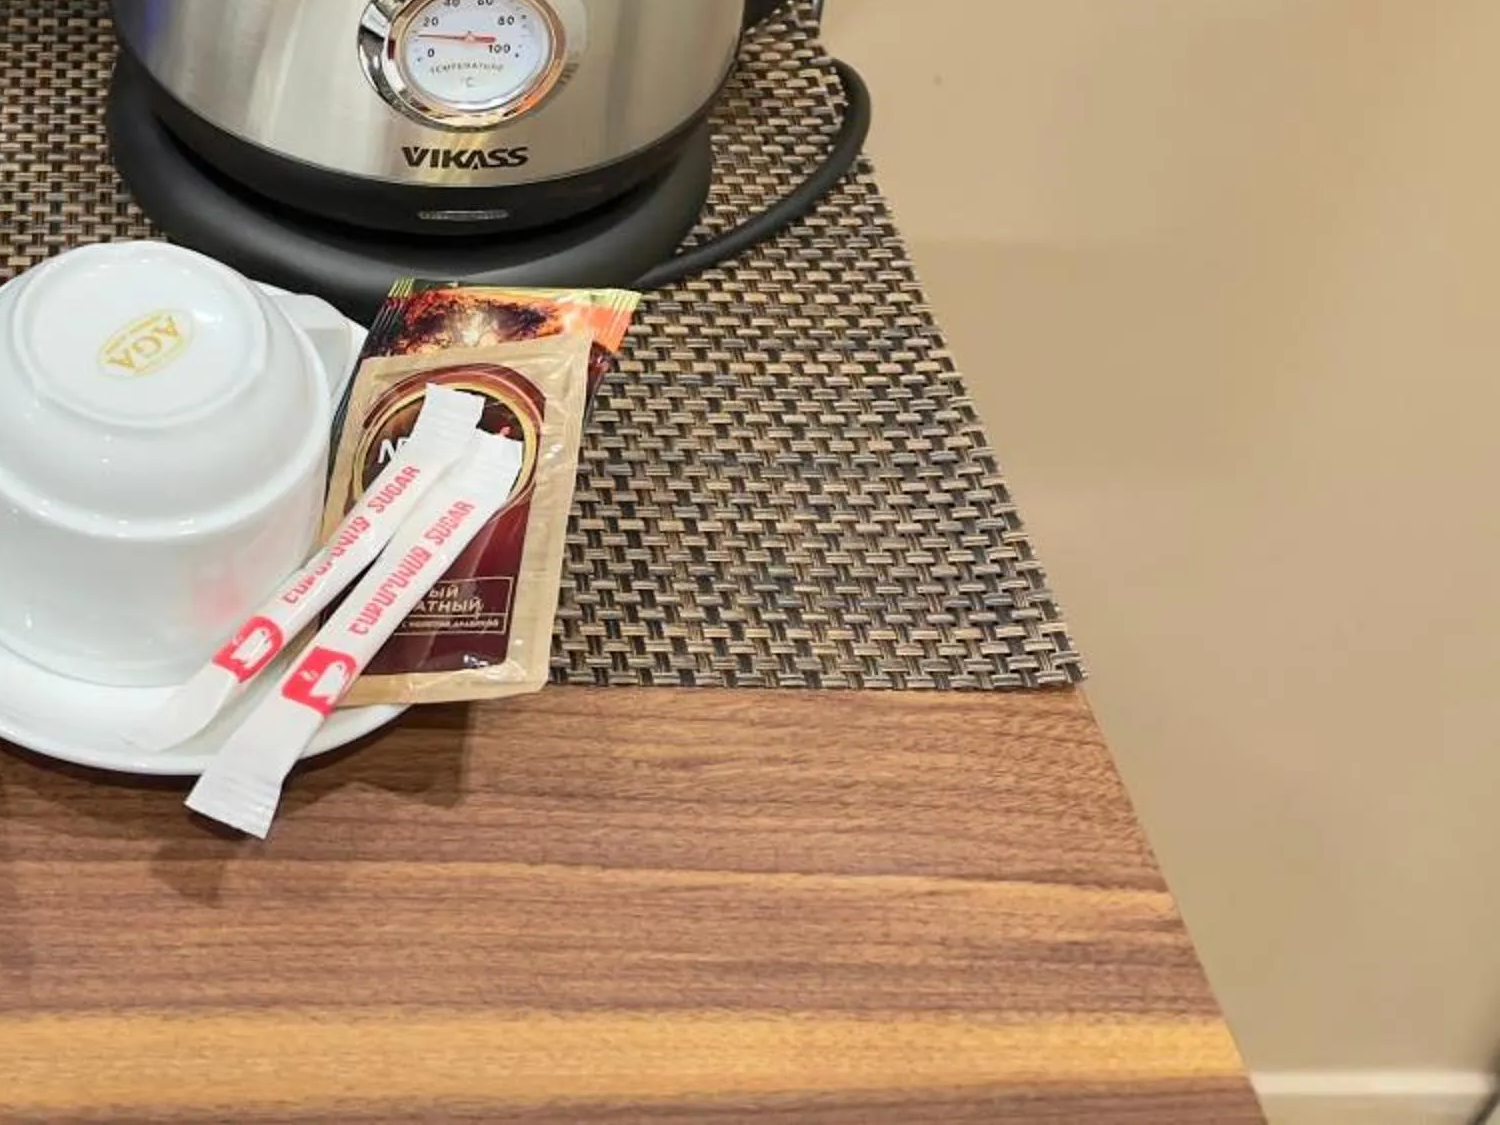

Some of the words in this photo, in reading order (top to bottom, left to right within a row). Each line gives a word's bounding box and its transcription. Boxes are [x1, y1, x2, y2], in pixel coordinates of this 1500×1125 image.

[422, 16, 440, 27] 20
[497, 15, 516, 26] 80
[427, 48, 436, 59] 0
[487, 43, 512, 55] 100
[401, 146, 530, 170] VIKASS
[367, 466, 420, 514] SUGAR
[425, 500, 475, 546] SUGAR
